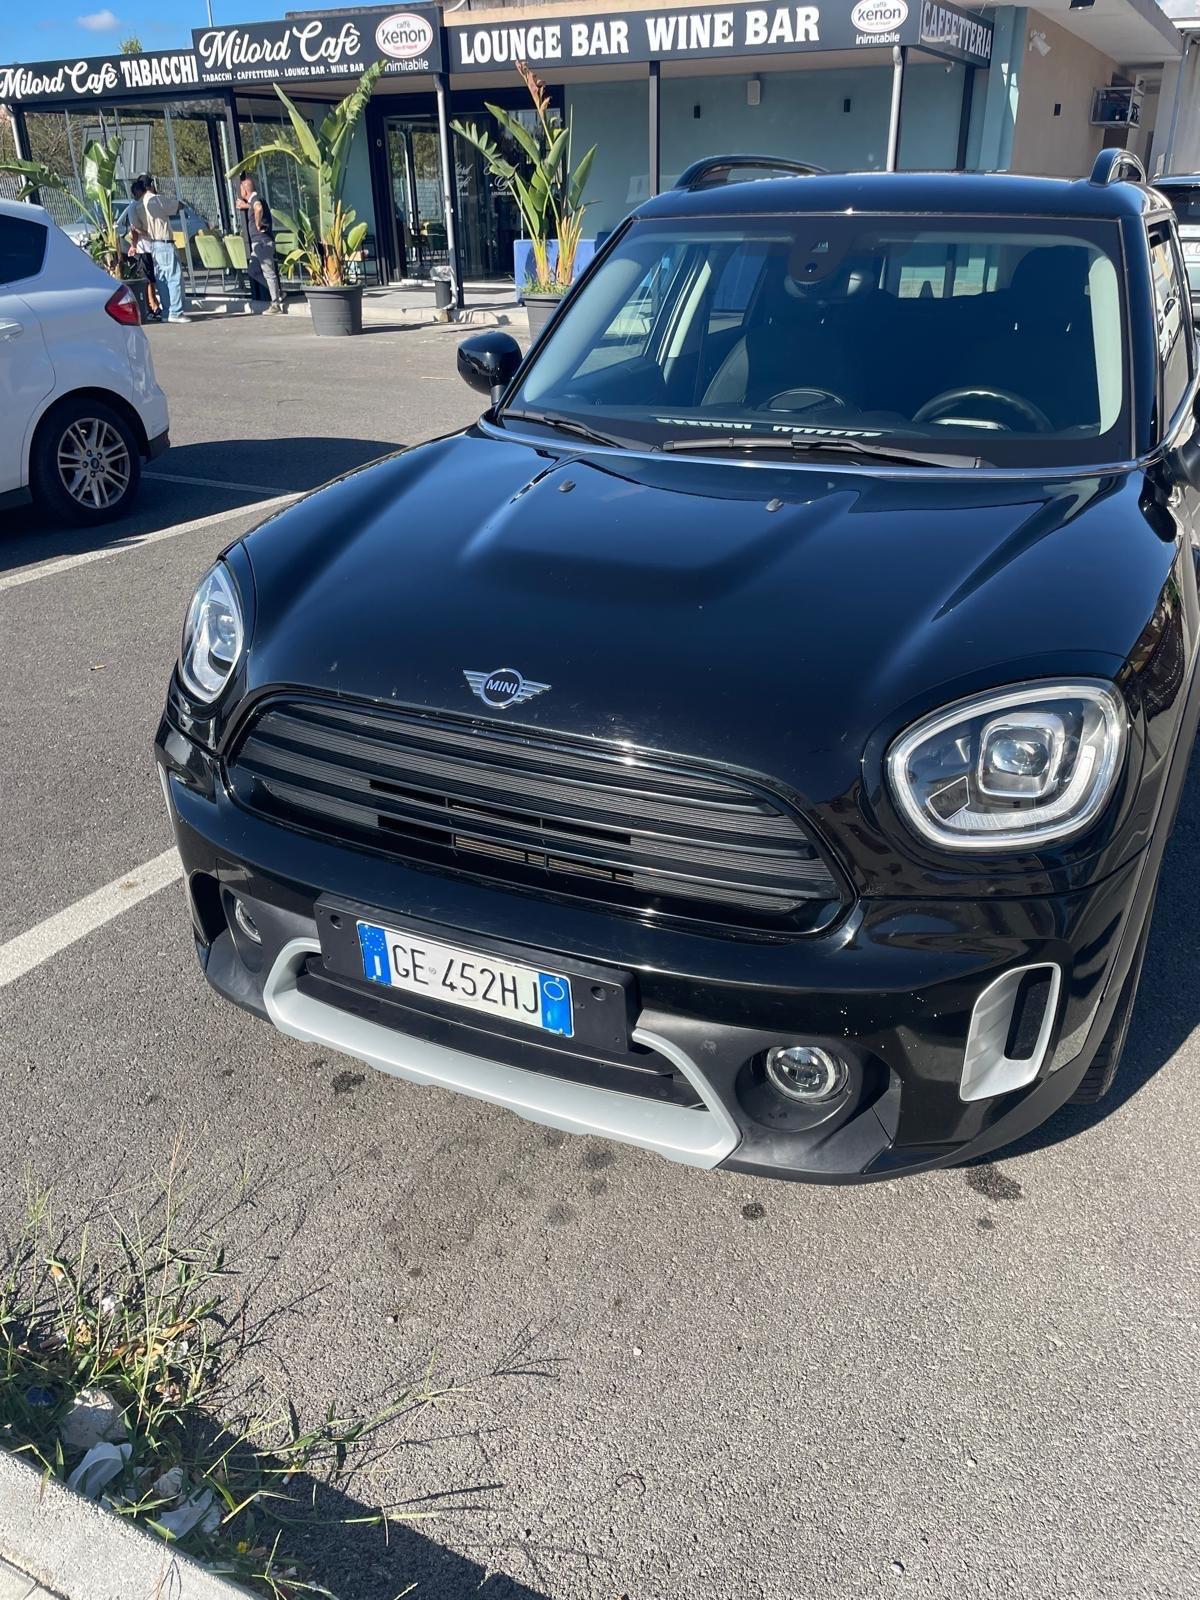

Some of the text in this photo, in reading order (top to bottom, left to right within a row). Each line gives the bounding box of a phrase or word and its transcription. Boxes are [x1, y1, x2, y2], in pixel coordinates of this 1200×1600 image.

[857, 8, 901, 21] kenon
[382, 29, 427, 45] kenon
[459, 7, 820, 64] LOUNGE BAR WINE BAR
[855, 32, 900, 45] inimitabile
[922, 1, 992, 59] CAFFETTERIA
[199, 30, 291, 70] Milord
[0, 68, 65, 99] Milord
[120, 55, 199, 88] TABACCHI
[202, 63, 365, 83] TABACCHI CAFFETTERIA LOUNGE BAR WINE BAR
[486, 679, 518, 694] MINI
[392, 944, 539, 1014] GE 452HJ
